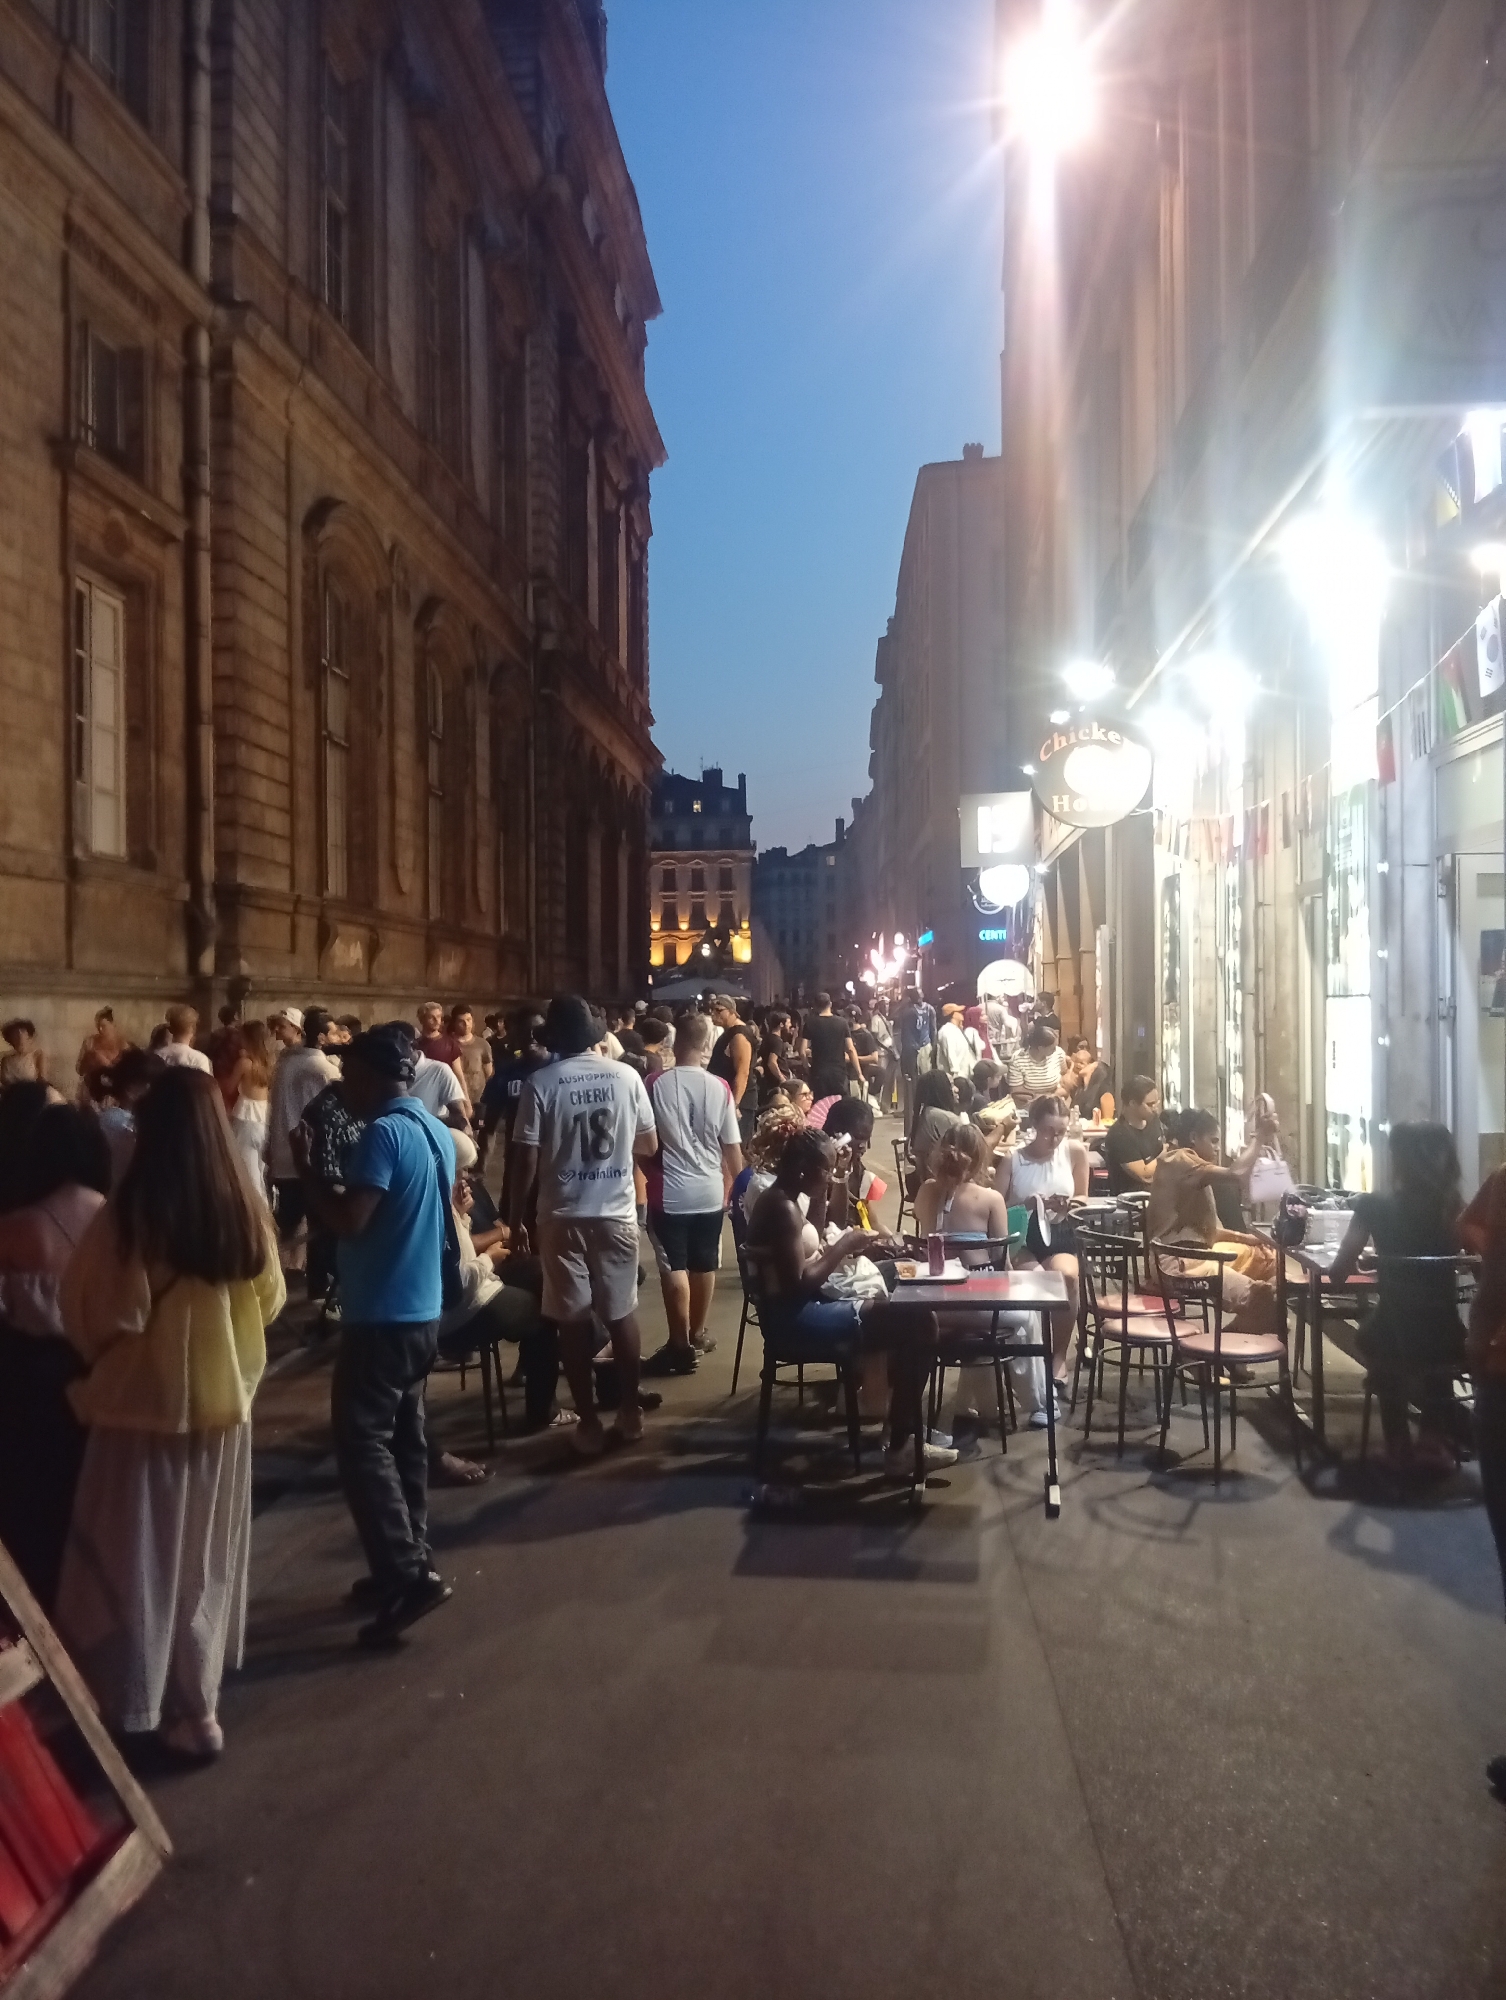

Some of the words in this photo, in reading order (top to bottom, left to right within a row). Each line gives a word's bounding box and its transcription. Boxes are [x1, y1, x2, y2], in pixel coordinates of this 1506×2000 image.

[569, 1083, 615, 1106] CHERKI
[573, 1107, 615, 1162] 18
[577, 1166, 628, 1181] trainline
